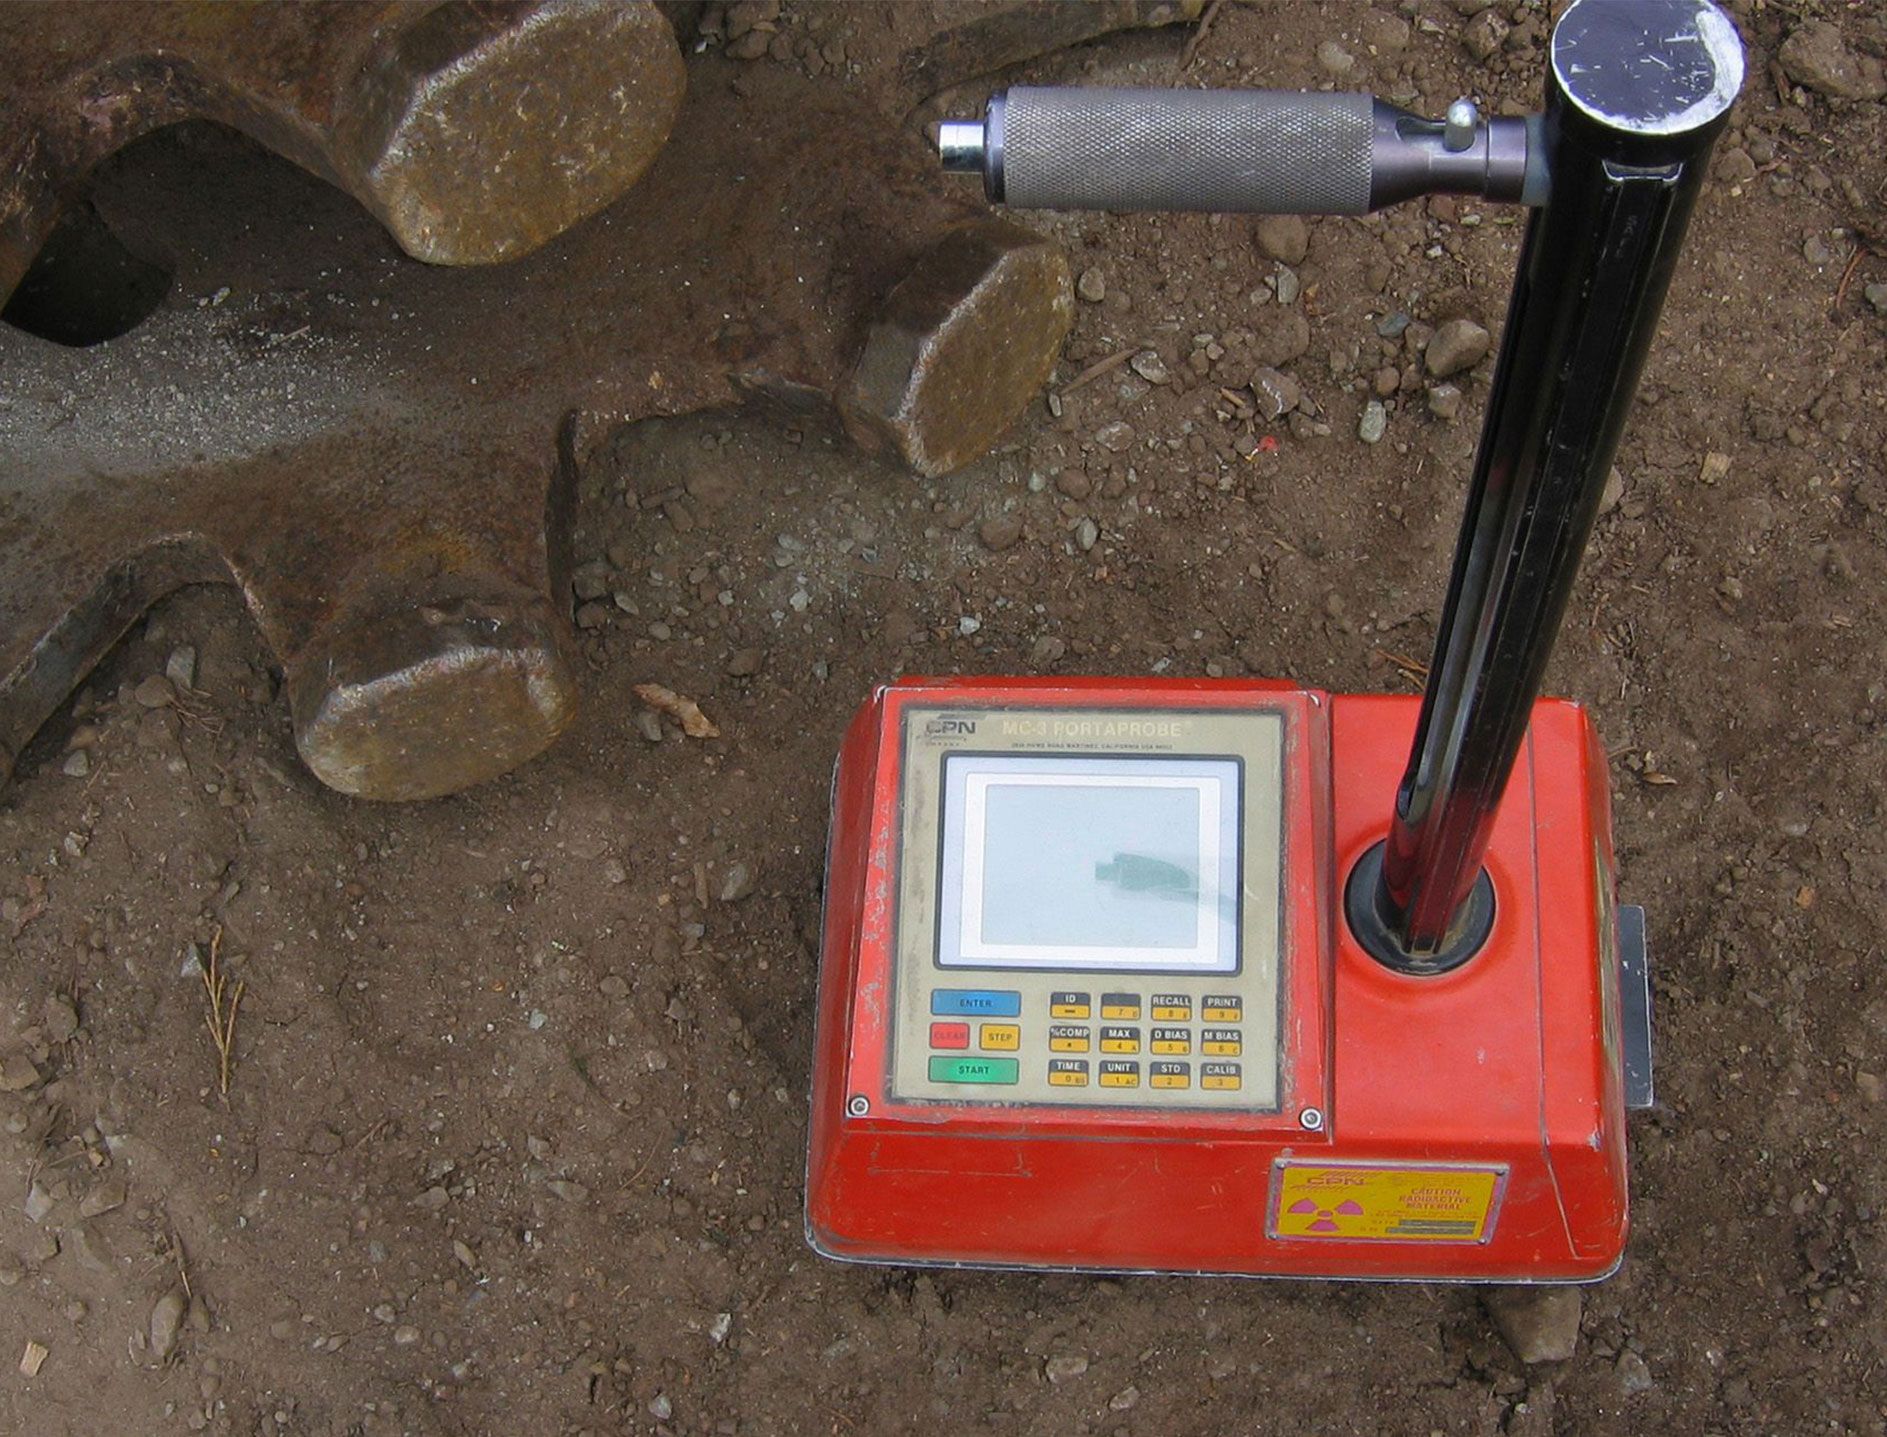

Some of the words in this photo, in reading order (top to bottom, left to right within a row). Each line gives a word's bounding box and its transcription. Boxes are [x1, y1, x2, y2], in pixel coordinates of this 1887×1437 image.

[1003, 720, 1047, 736] MC-3
[1054, 721, 1182, 737] PORTAPROBE
[960, 999, 993, 1007] ENTER
[1065, 994, 1077, 1004] ID
[1152, 996, 1191, 1006] RECALL
[1207, 998, 1237, 1007] PRINT
[988, 1033, 1013, 1041] STEP
[1050, 1027, 1090, 1038] %COMP
[1108, 1029, 1131, 1038] MAX
[1164, 1030, 1188, 1040] BIAS
[1204, 1031, 1213, 1040] M
[1215, 1032, 1239, 1041] BIAS
[958, 1065, 990, 1074] START
[1056, 1061, 1081, 1071] TIME
[1107, 1063, 1132, 1072] UNIT
[1160, 1064, 1181, 1073] STD
[1206, 1065, 1237, 1075] CALIB
[1411, 1187, 1462, 1196] CAUTION
[1398, 1195, 1472, 1204] RADIOACTIVE
[1405, 1202, 1461, 1211] MATERIAL
